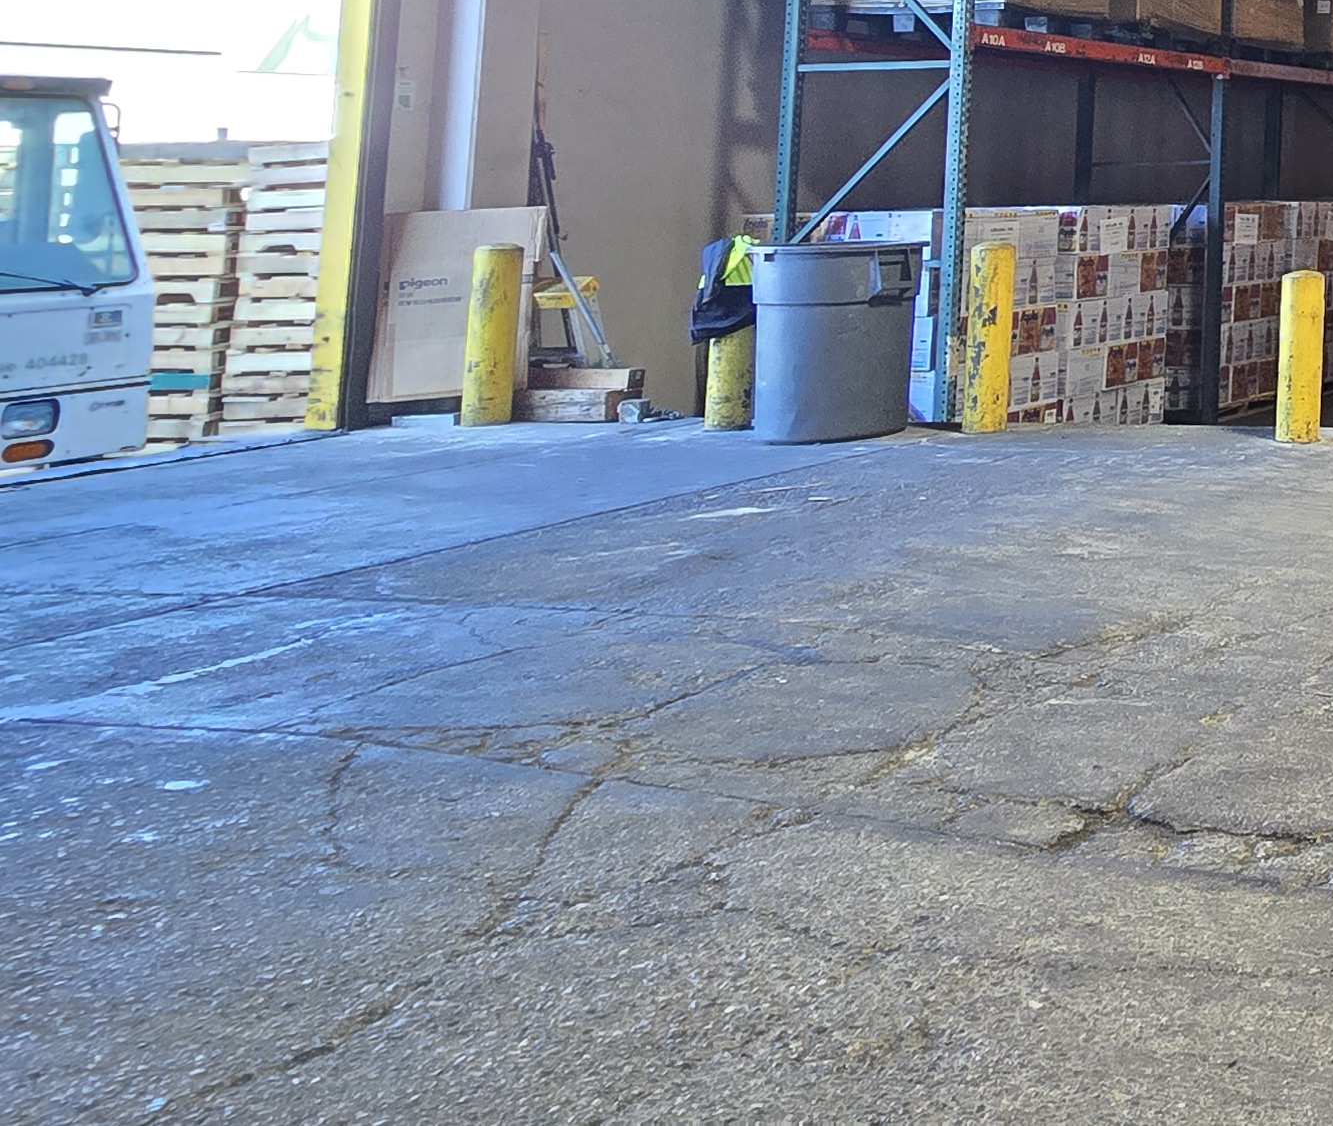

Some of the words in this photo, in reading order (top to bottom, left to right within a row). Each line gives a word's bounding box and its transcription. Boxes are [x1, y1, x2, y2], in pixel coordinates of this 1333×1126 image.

[981, 32, 1006, 47] A10A
[1044, 40, 1066, 54] A10B
[399, 277, 448, 291] pigeon
